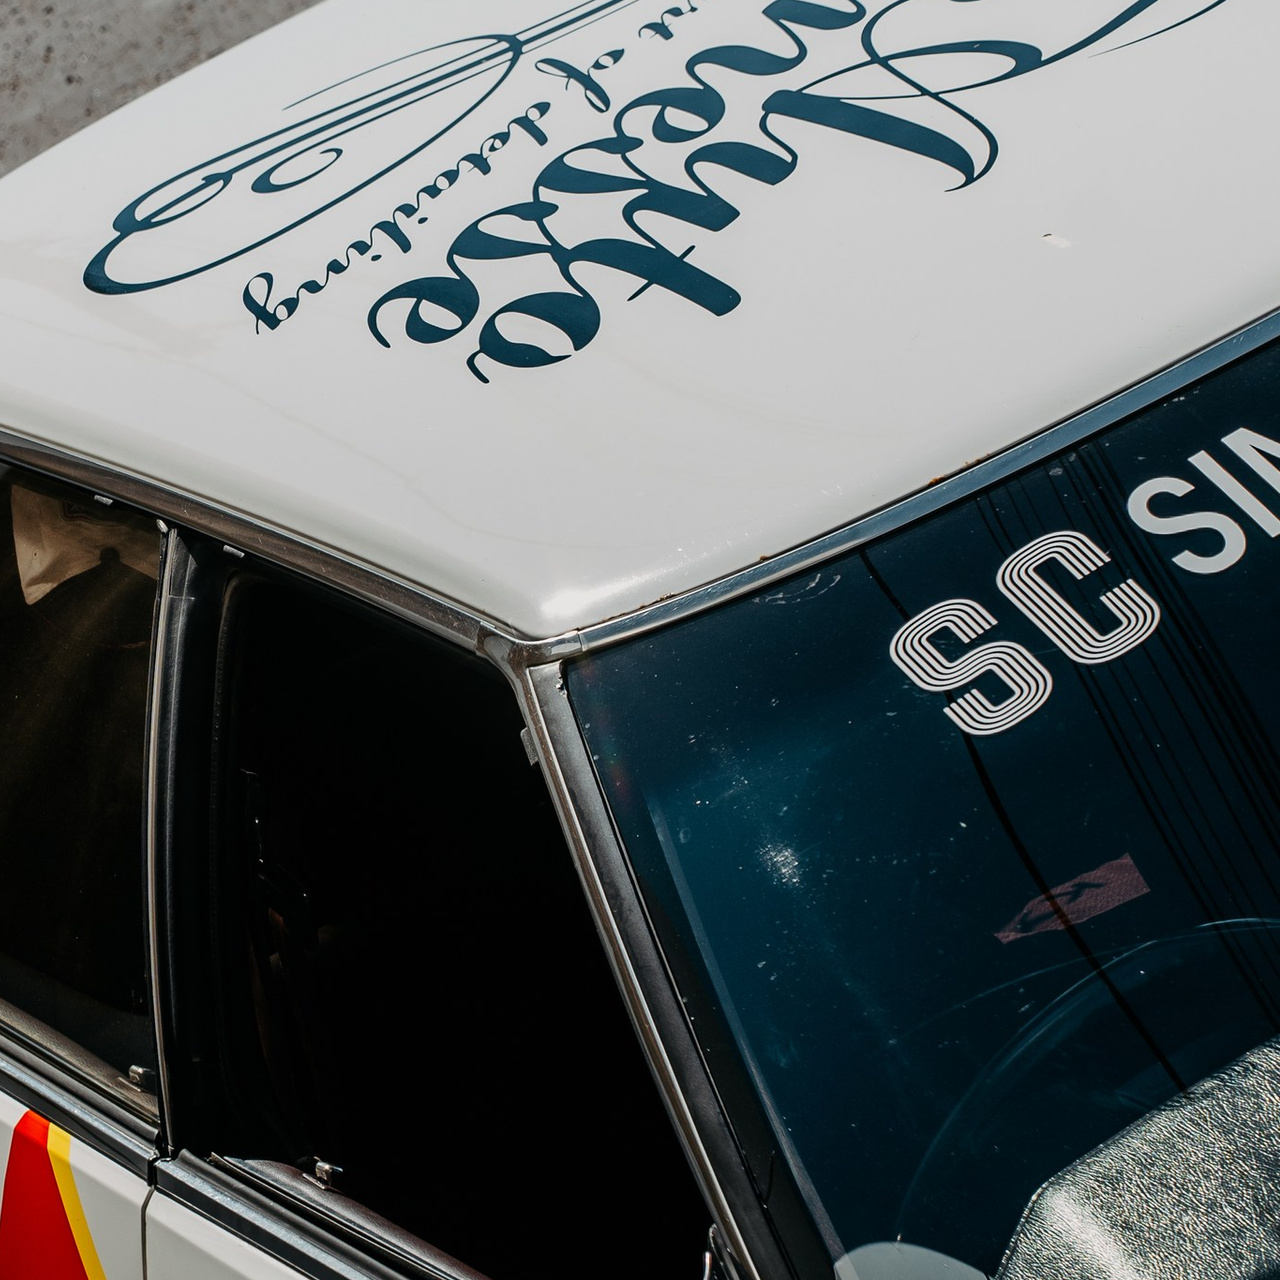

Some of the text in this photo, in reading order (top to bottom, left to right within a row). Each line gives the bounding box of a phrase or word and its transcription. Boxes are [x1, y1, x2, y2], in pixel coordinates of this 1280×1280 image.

[536, 46, 626, 114] of
[241, 100, 552, 335] detailing
[889, 530, 1161, 736] SC
